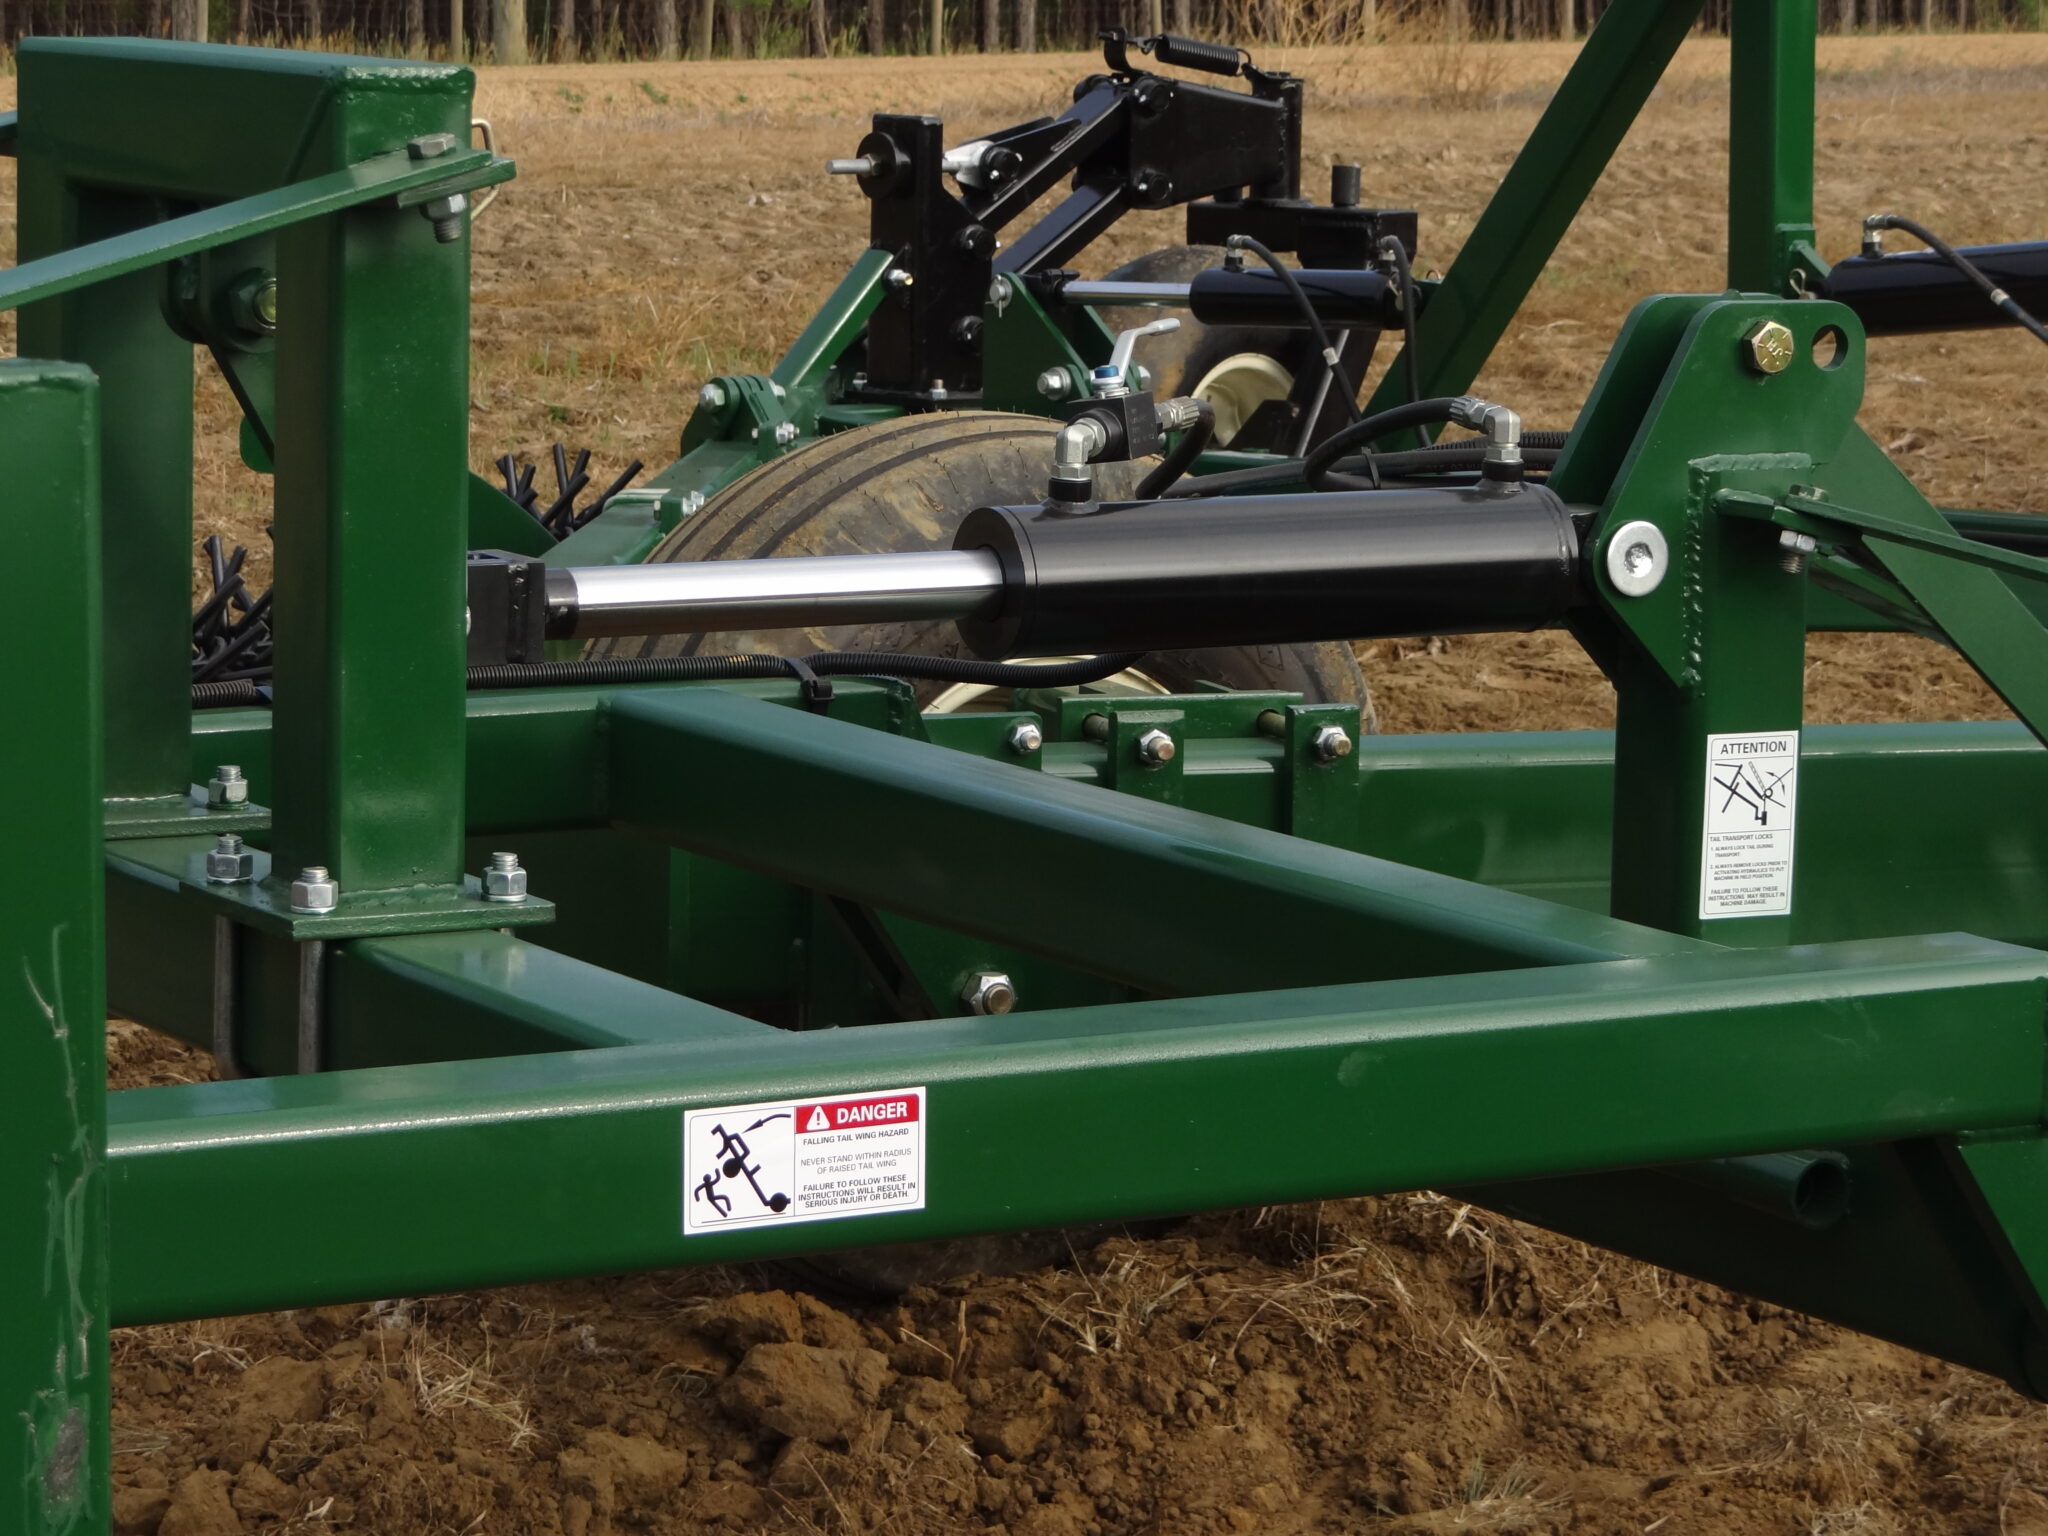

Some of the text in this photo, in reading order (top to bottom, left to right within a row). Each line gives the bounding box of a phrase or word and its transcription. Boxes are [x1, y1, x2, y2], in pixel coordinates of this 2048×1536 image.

[1720, 741, 1787, 754] ATTENTION
[836, 1102, 908, 1124] DANGER
[803, 1128, 909, 1145] FALLING TAIL WING HAZARD
[800, 1148, 911, 1166] NEVER STAND WITHIN RADIUS
[817, 1159, 896, 1174] OF RAISED TAIL WING
[798, 1189, 855, 1201] INSTRUCTIONS
[856, 1186, 875, 1195] WILL
[877, 1183, 905, 1193] RESULT
[803, 1182, 835, 1192] FAILURE
[849, 1177, 881, 1186] FOLLOW
[883, 1174, 907, 1183] THESE
[805, 1190, 909, 1208] SERIOUS INJURY OR DEATH.
